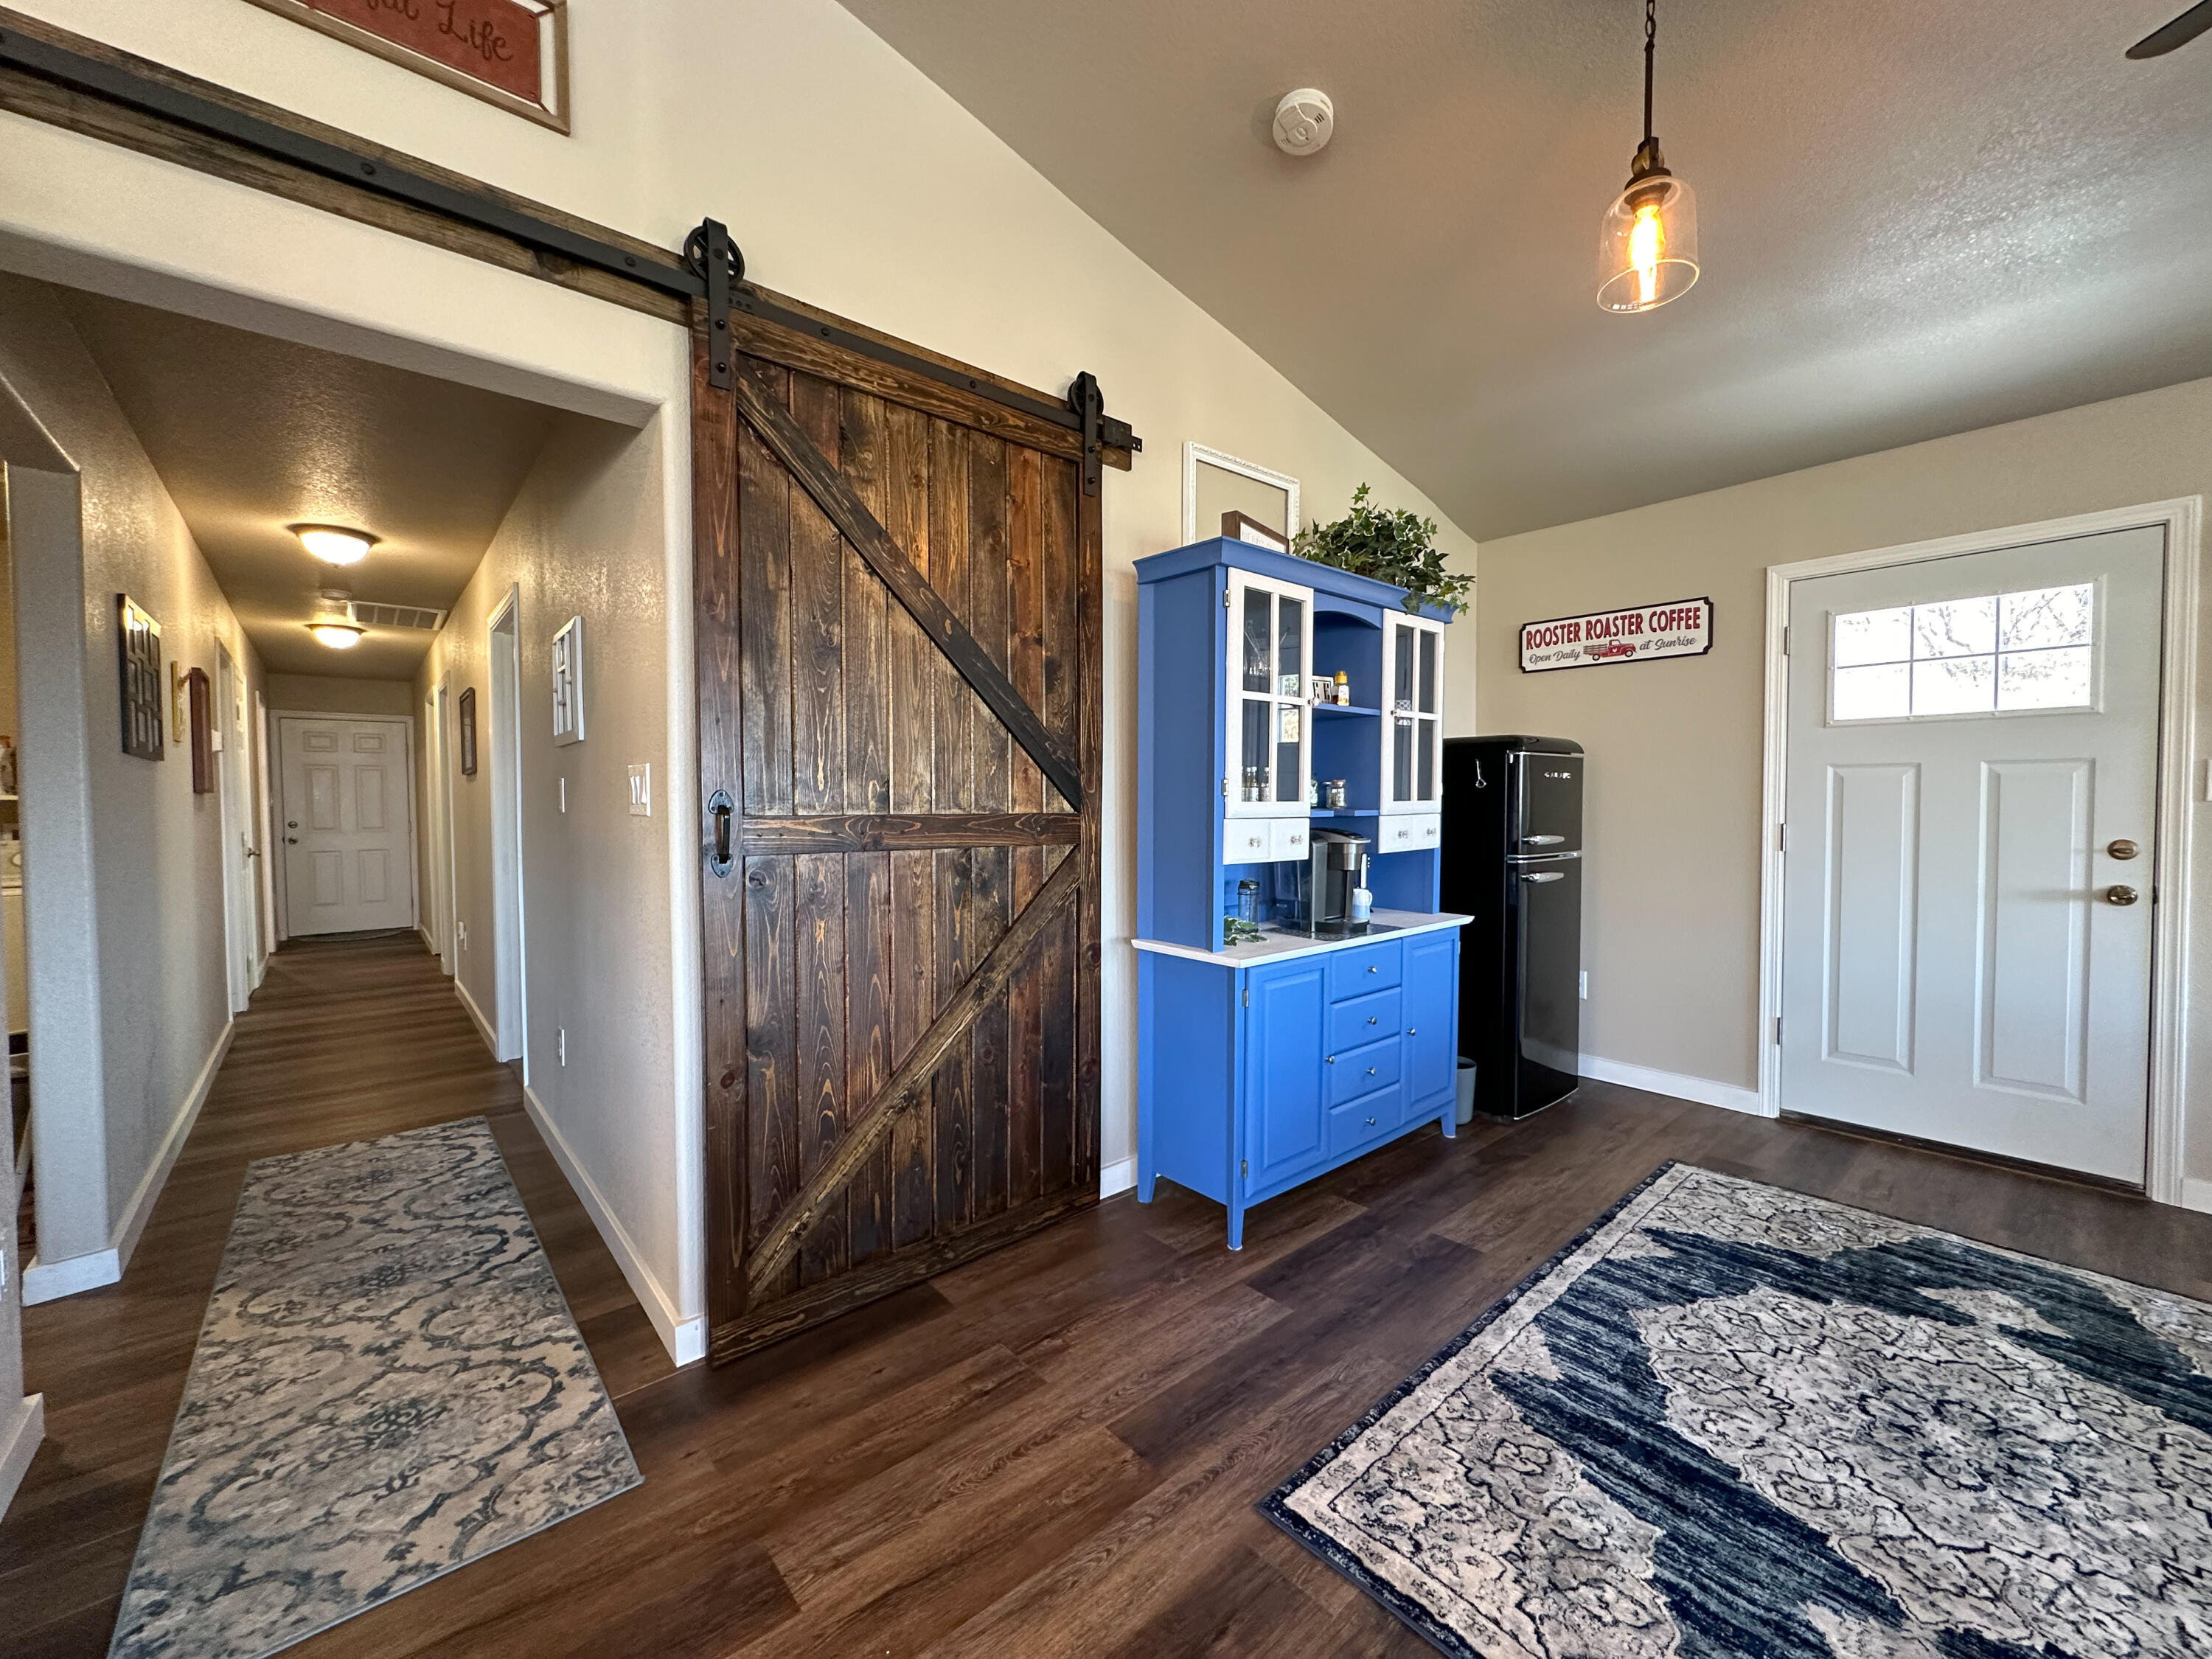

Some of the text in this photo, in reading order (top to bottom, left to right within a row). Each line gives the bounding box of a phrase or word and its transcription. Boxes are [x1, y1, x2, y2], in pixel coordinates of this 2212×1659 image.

[437, 0, 514, 61] Life
[1526, 607, 1700, 650] ROOSTER ROASTER COFFEE
[1529, 636, 1697, 665] Open Daily at Sunrise
